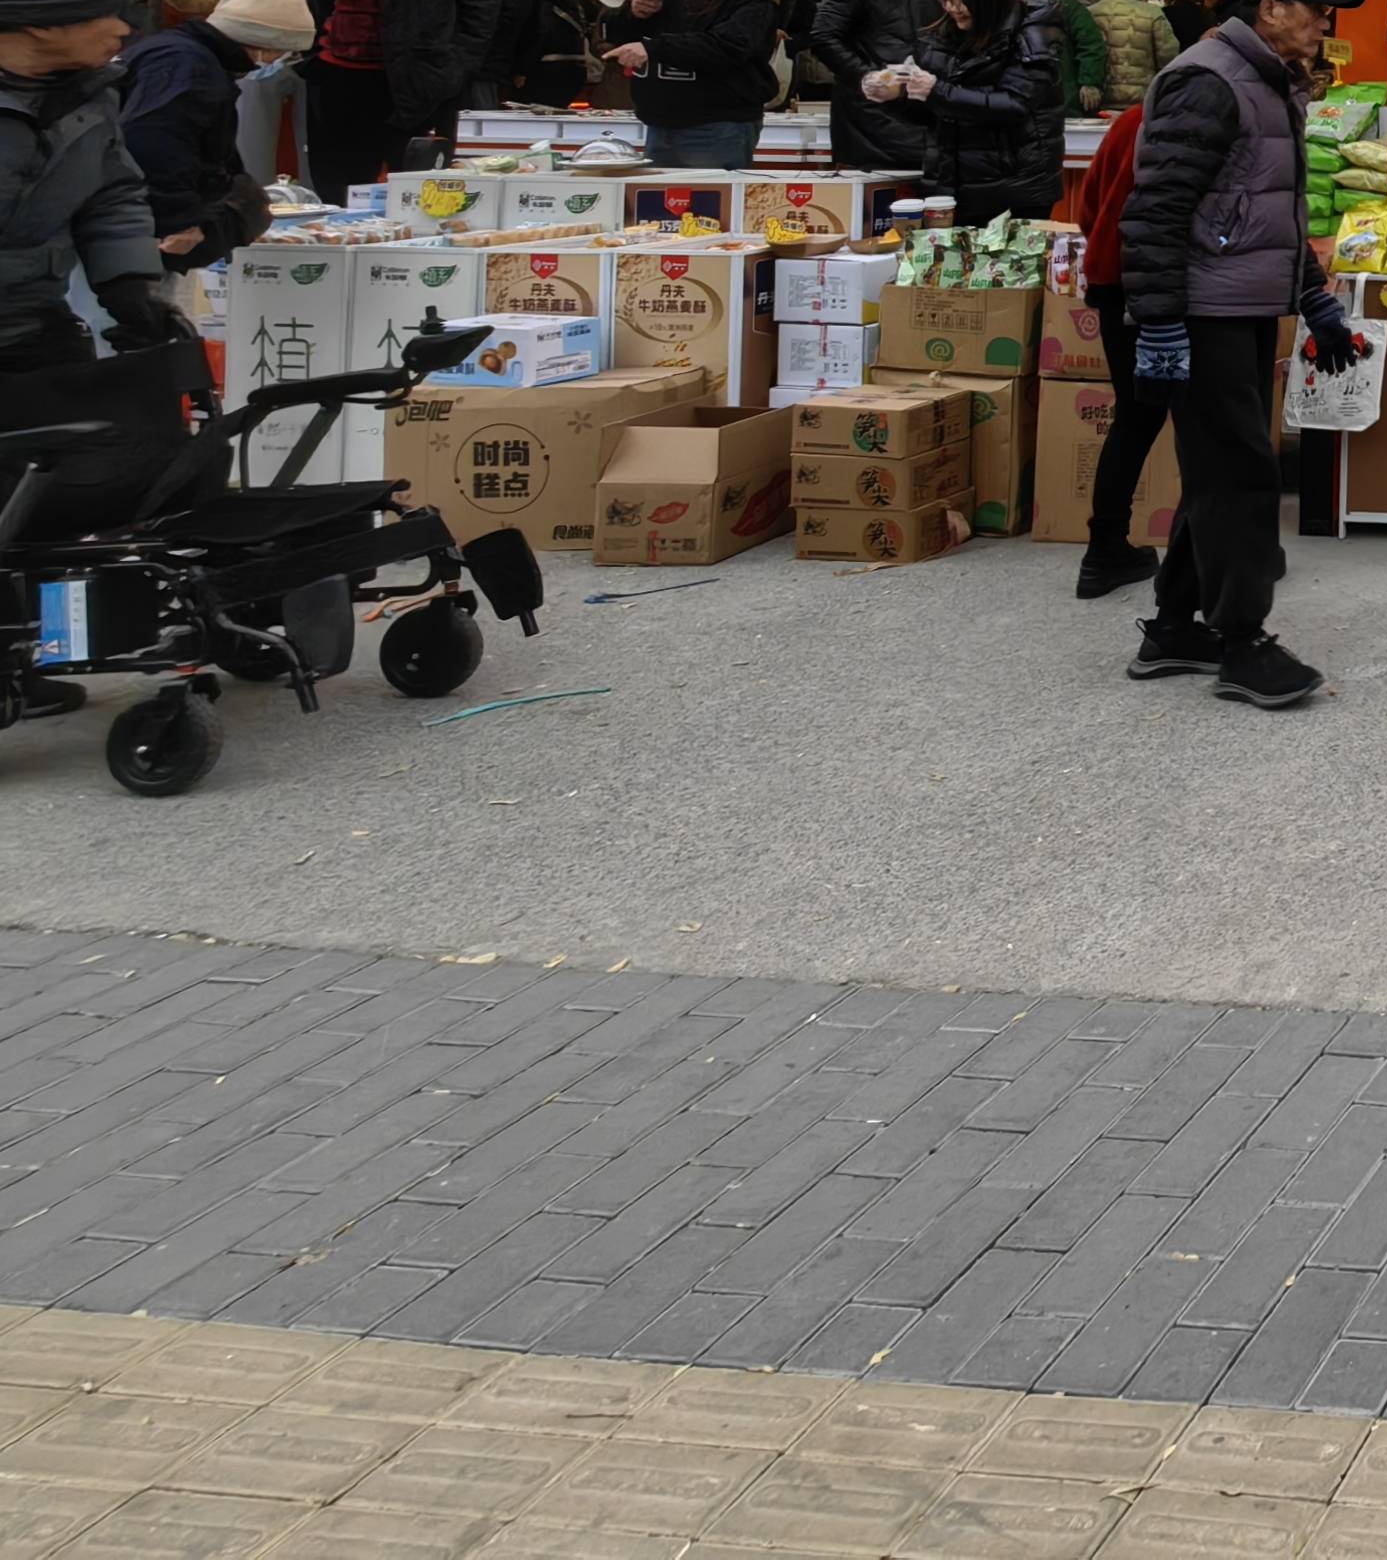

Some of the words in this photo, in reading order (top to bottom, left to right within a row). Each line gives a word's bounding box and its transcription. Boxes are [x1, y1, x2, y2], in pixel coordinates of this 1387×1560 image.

[529, 283, 555, 297] 丹夫
[659, 284, 685, 298] 丹夫
[509, 298, 577, 313] 牛奶燕麦酥
[637, 299, 707, 315] 牛奶燕麦酥
[473, 440, 530, 467] 时尚
[473, 472, 530, 499] 糕点
